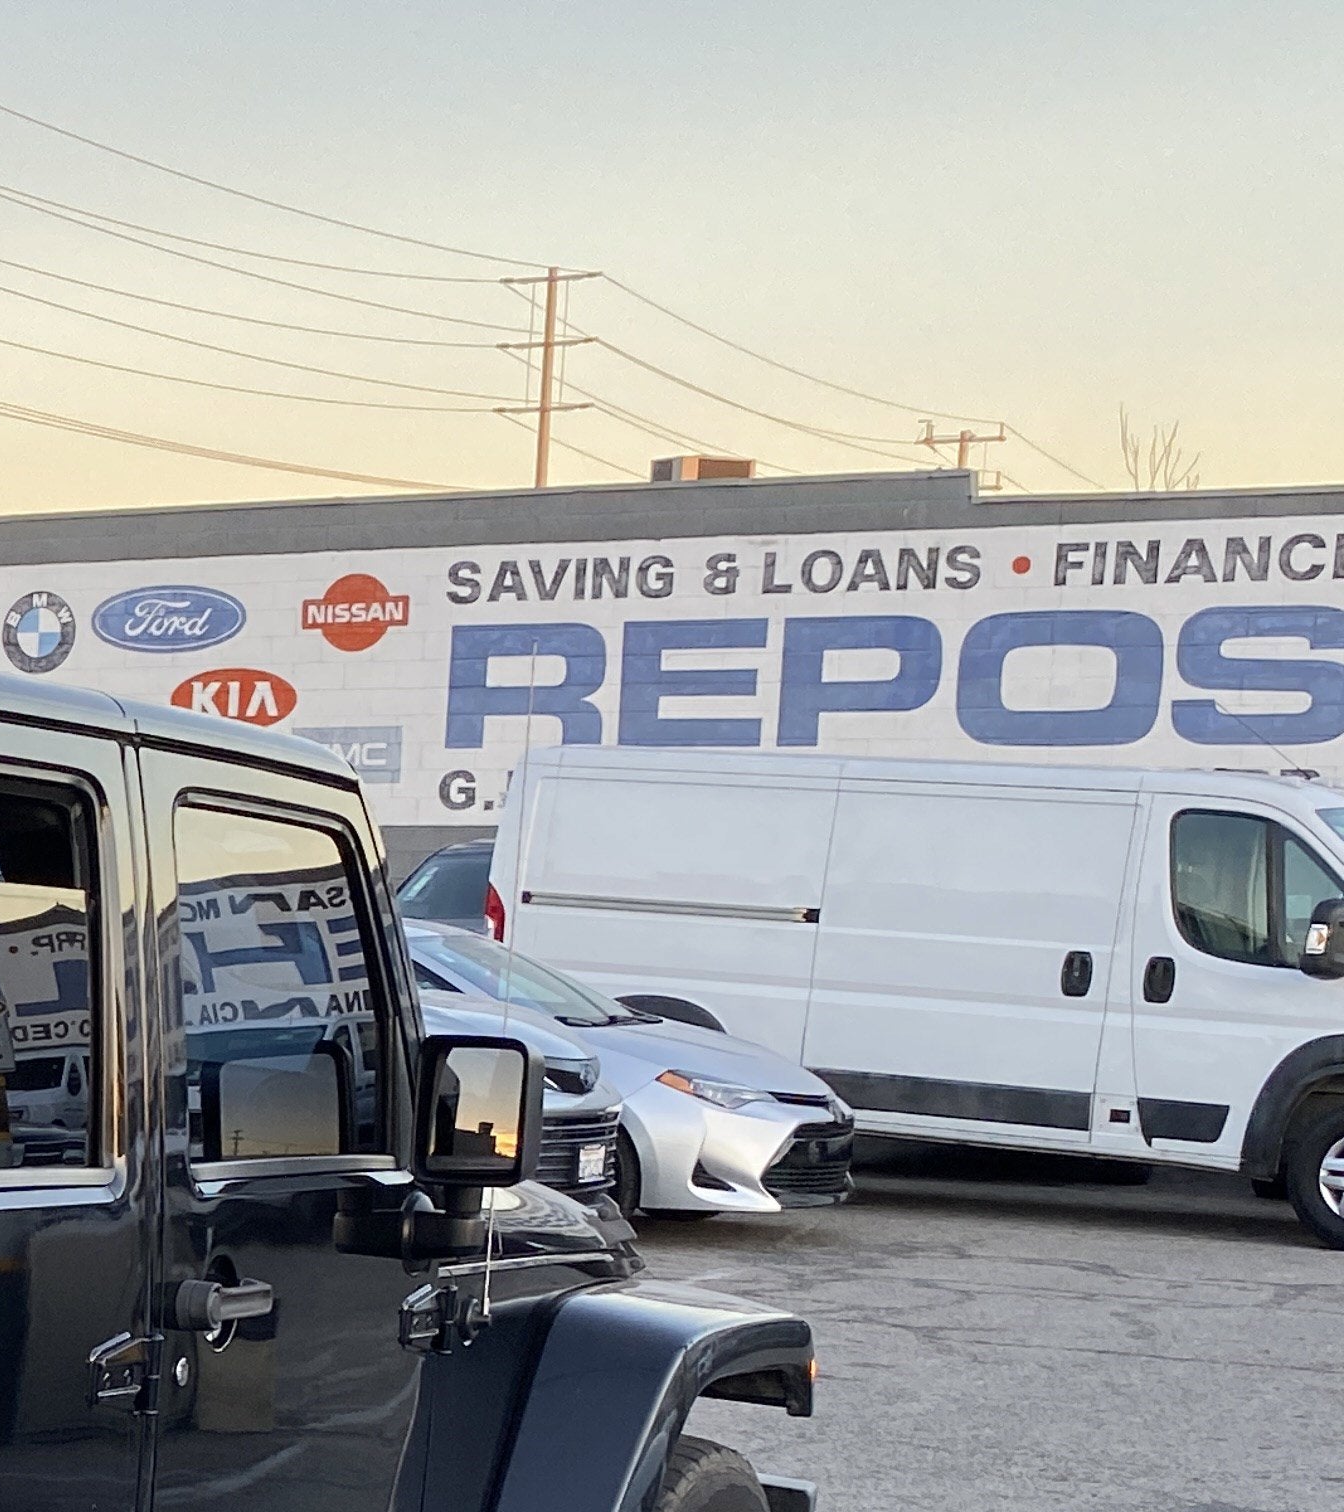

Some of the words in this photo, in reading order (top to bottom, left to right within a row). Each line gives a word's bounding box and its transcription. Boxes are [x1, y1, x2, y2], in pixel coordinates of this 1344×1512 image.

[446, 554, 675, 605] SAVING
[702, 552, 740, 595] &
[761, 544, 982, 594] LOANS
[5, 592, 74, 630] BMW
[124, 598, 213, 639] Ford
[305, 599, 406, 626] NISSAN
[445, 605, 1344, 749] REPOS
[191, 681, 280, 718] KIA
[330, 741, 388, 767] MC
